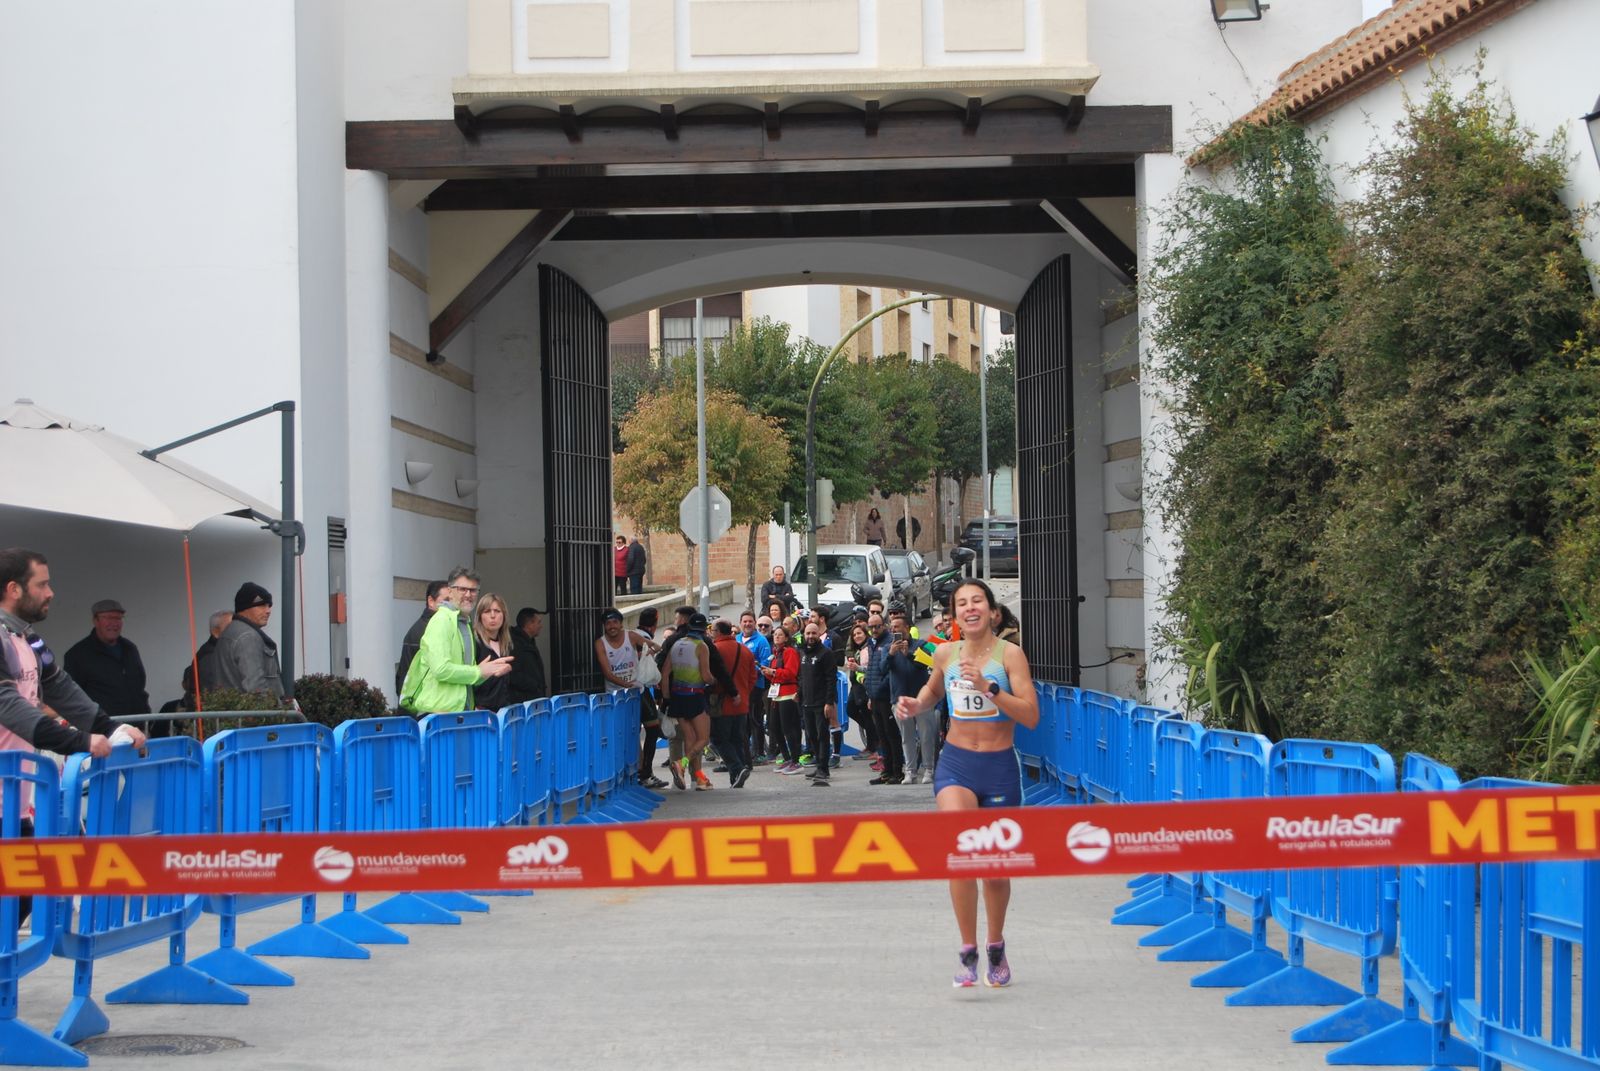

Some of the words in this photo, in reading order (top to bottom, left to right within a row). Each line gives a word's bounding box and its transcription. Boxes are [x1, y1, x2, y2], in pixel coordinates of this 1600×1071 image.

[963, 695, 984, 710] 19
[1266, 813, 1401, 838] RotulaSur
[1114, 826, 1233, 845] mundaventos
[1329, 839, 1338, 849] &
[605, 821, 919, 879] META
[165, 850, 283, 869] RotulaSur
[357, 852, 467, 866] mundaventos
[222, 869, 229, 878] &
